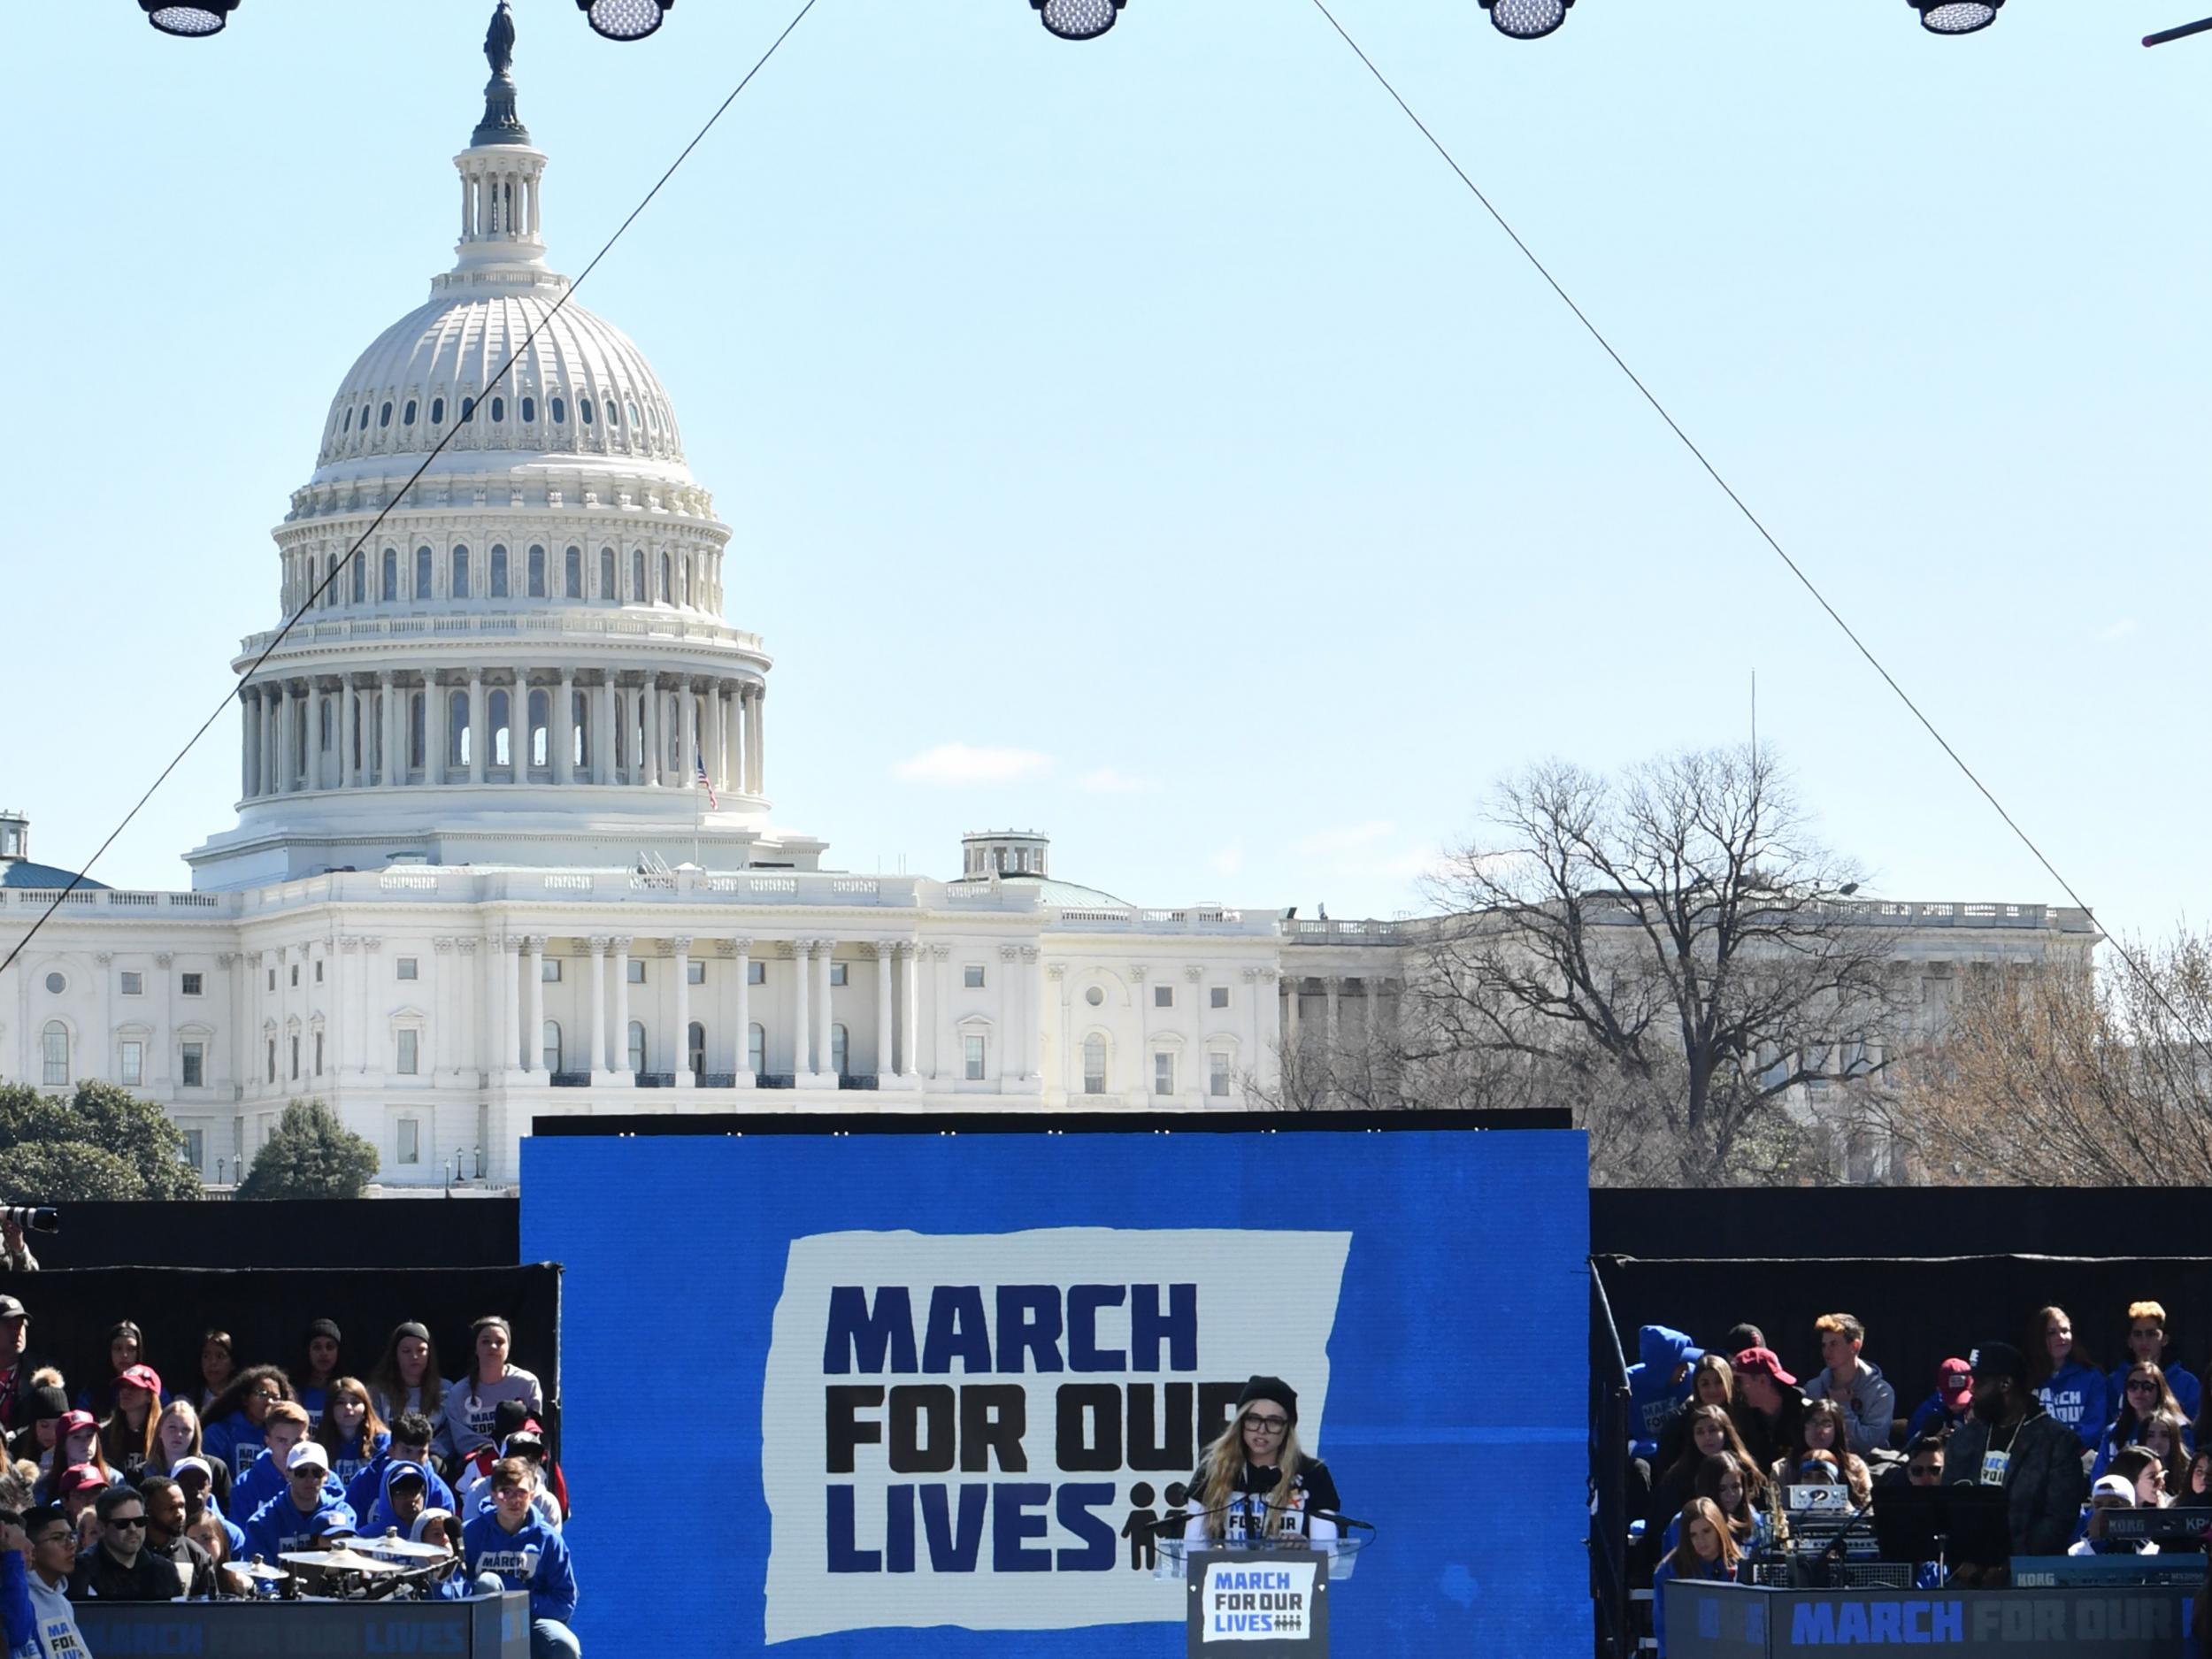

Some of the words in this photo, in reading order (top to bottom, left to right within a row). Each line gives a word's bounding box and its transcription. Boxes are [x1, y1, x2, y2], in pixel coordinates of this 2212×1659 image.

[823, 1284, 1198, 1374] MARCH
[826, 1384, 1028, 1473] FOR
[826, 1482, 1117, 1573] LIVES
[2108, 1519, 2145, 1532] KORG
[1215, 1572, 1290, 1590] MARCH
[2016, 1572, 2055, 1586] KORG
[1215, 1594, 1256, 1610] FOR
[1260, 1593, 1302, 1610] OUR
[1215, 1615, 1272, 1632] LIVES
[1791, 1601, 1963, 1645] MARCH
[1973, 1600, 2067, 1642] FOR
[2076, 1598, 2172, 1642] OUR
[365, 1621, 465, 1654] LIVES
